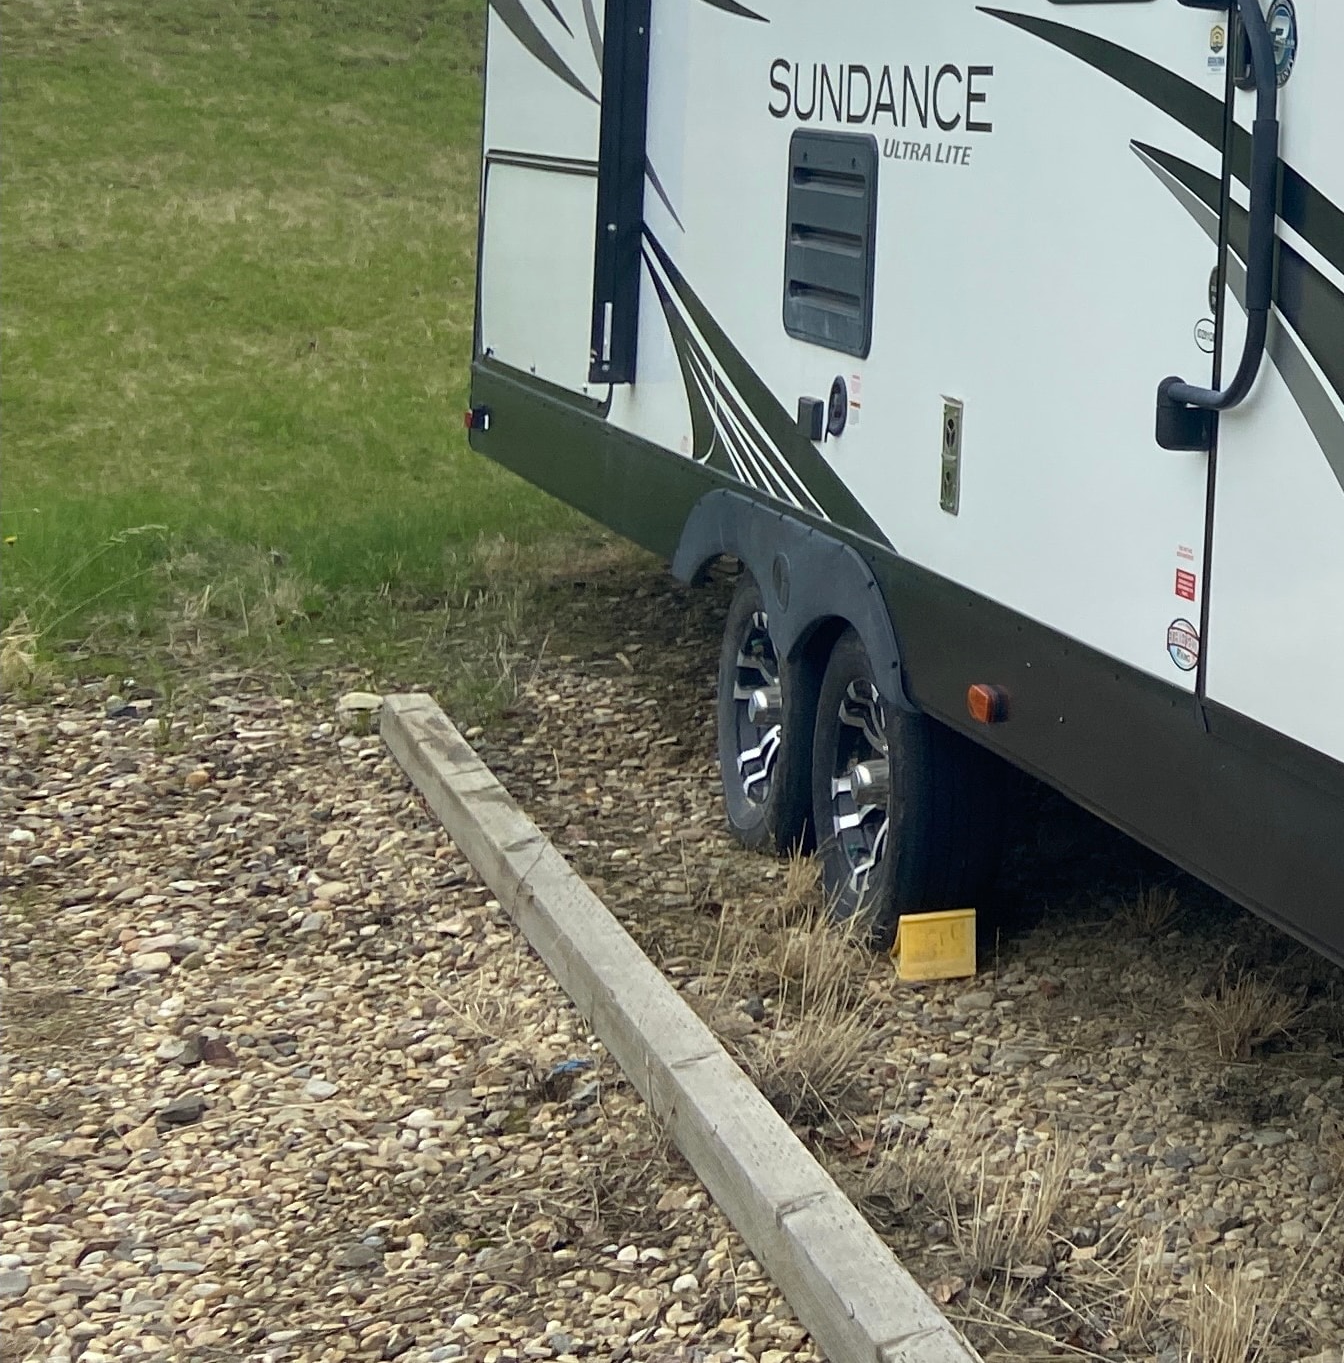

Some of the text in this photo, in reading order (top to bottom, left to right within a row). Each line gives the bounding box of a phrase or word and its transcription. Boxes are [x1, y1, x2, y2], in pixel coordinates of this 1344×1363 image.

[768, 58, 994, 133] SUNDANCE
[883, 138, 972, 166] ULTRA LITE
